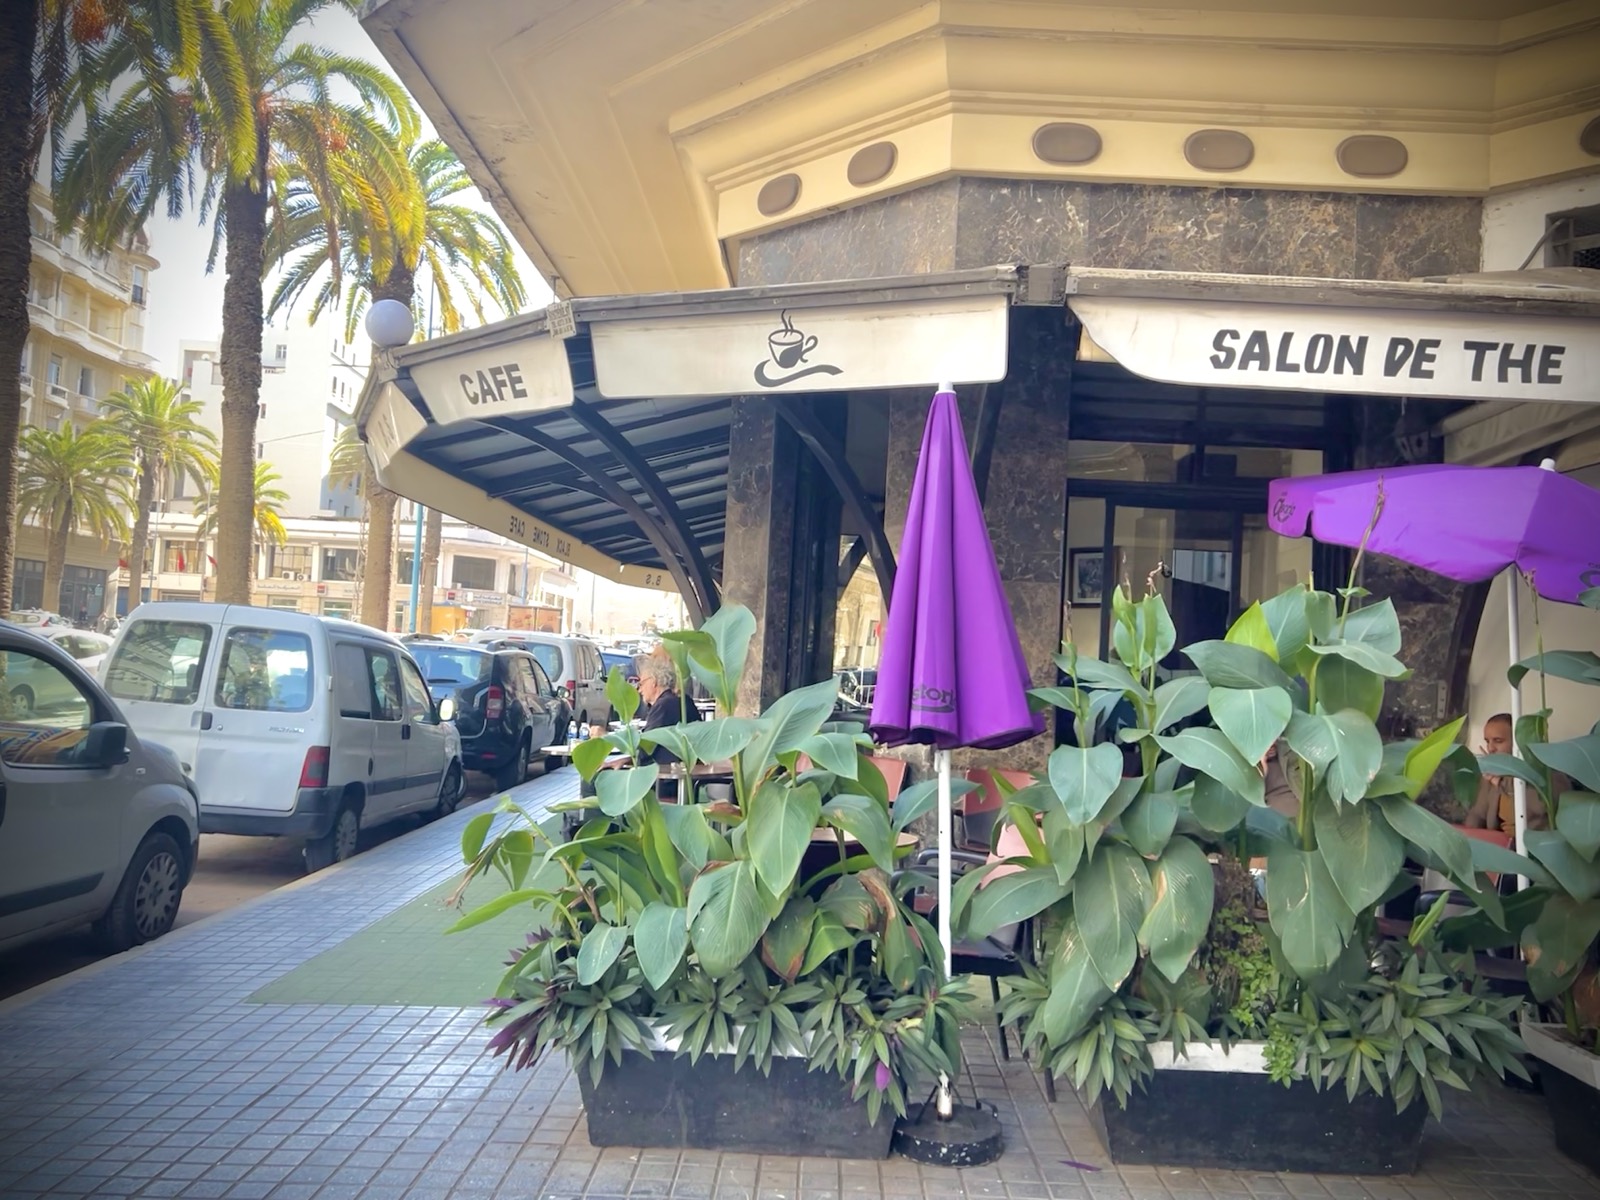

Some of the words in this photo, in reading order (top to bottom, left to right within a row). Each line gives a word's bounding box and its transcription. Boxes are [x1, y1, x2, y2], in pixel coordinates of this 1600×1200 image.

[1209, 329, 1369, 376] SALON
[1383, 336, 1441, 380] DE
[1463, 340, 1566, 385] THE
[459, 363, 528, 405] CAFE
